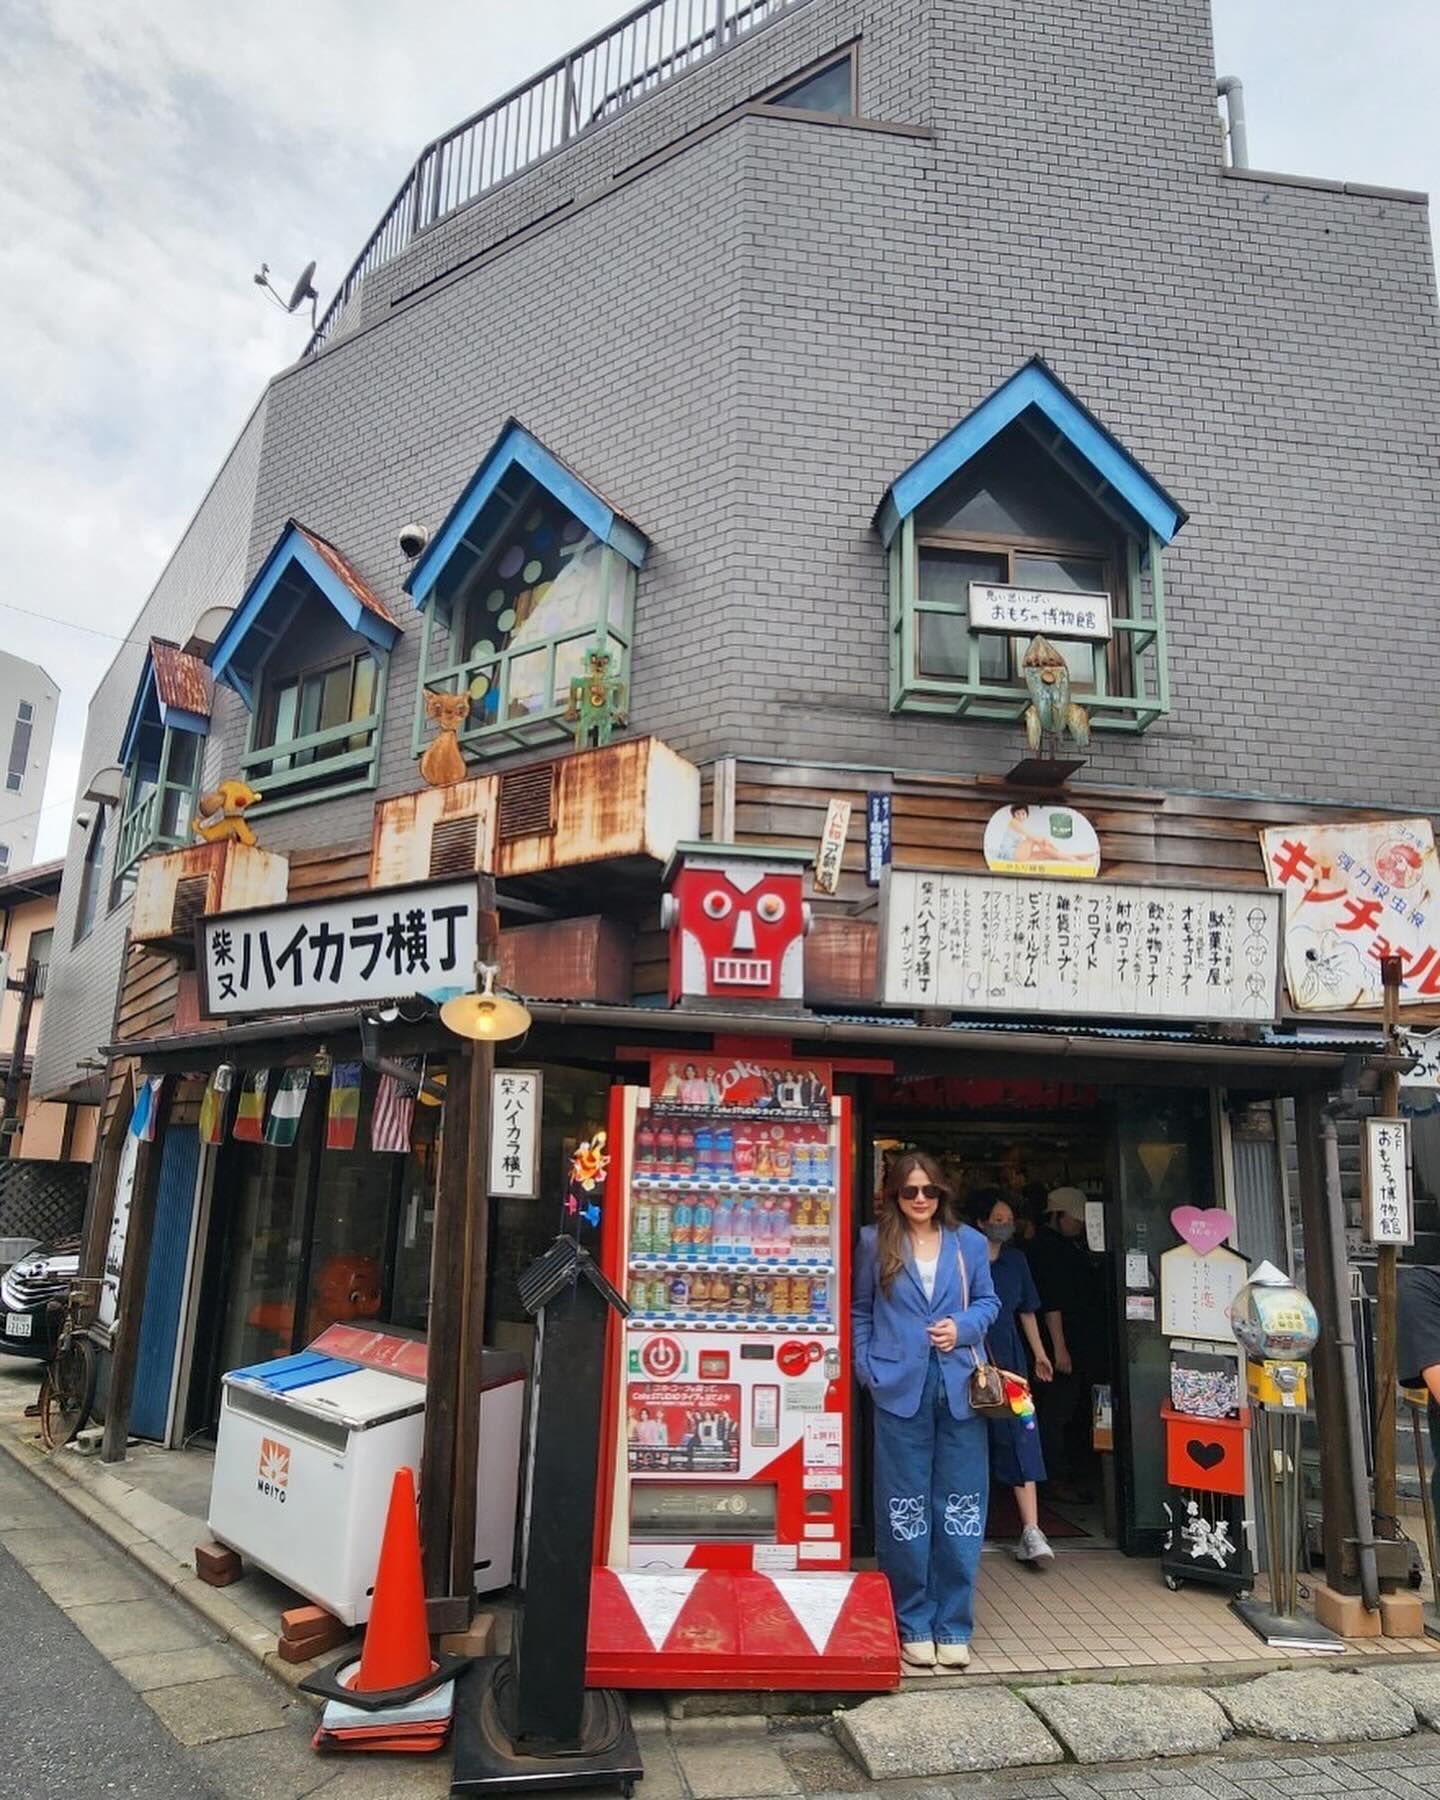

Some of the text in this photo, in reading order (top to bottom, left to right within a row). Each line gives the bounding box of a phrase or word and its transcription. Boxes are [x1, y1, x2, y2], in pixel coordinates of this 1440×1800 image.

[991, 605, 1096, 630] おもちゃ博物館
[1336, 851, 1426, 928] 強力殺虫液
[212, 905, 469, 1000] 柴又 ハイカラ横丁
[1056, 895, 1072, 984] 雑貨コーナー
[1116, 901, 1132, 983] 射的コーナー
[1146, 901, 1165, 997] 飲み物コーナー
[1205, 910, 1226, 987] 駄菓子屋
[501, 1078, 530, 1189] 柴又 ハイカラ横丁
[1379, 1128, 1402, 1235] おもちゃ博物館
